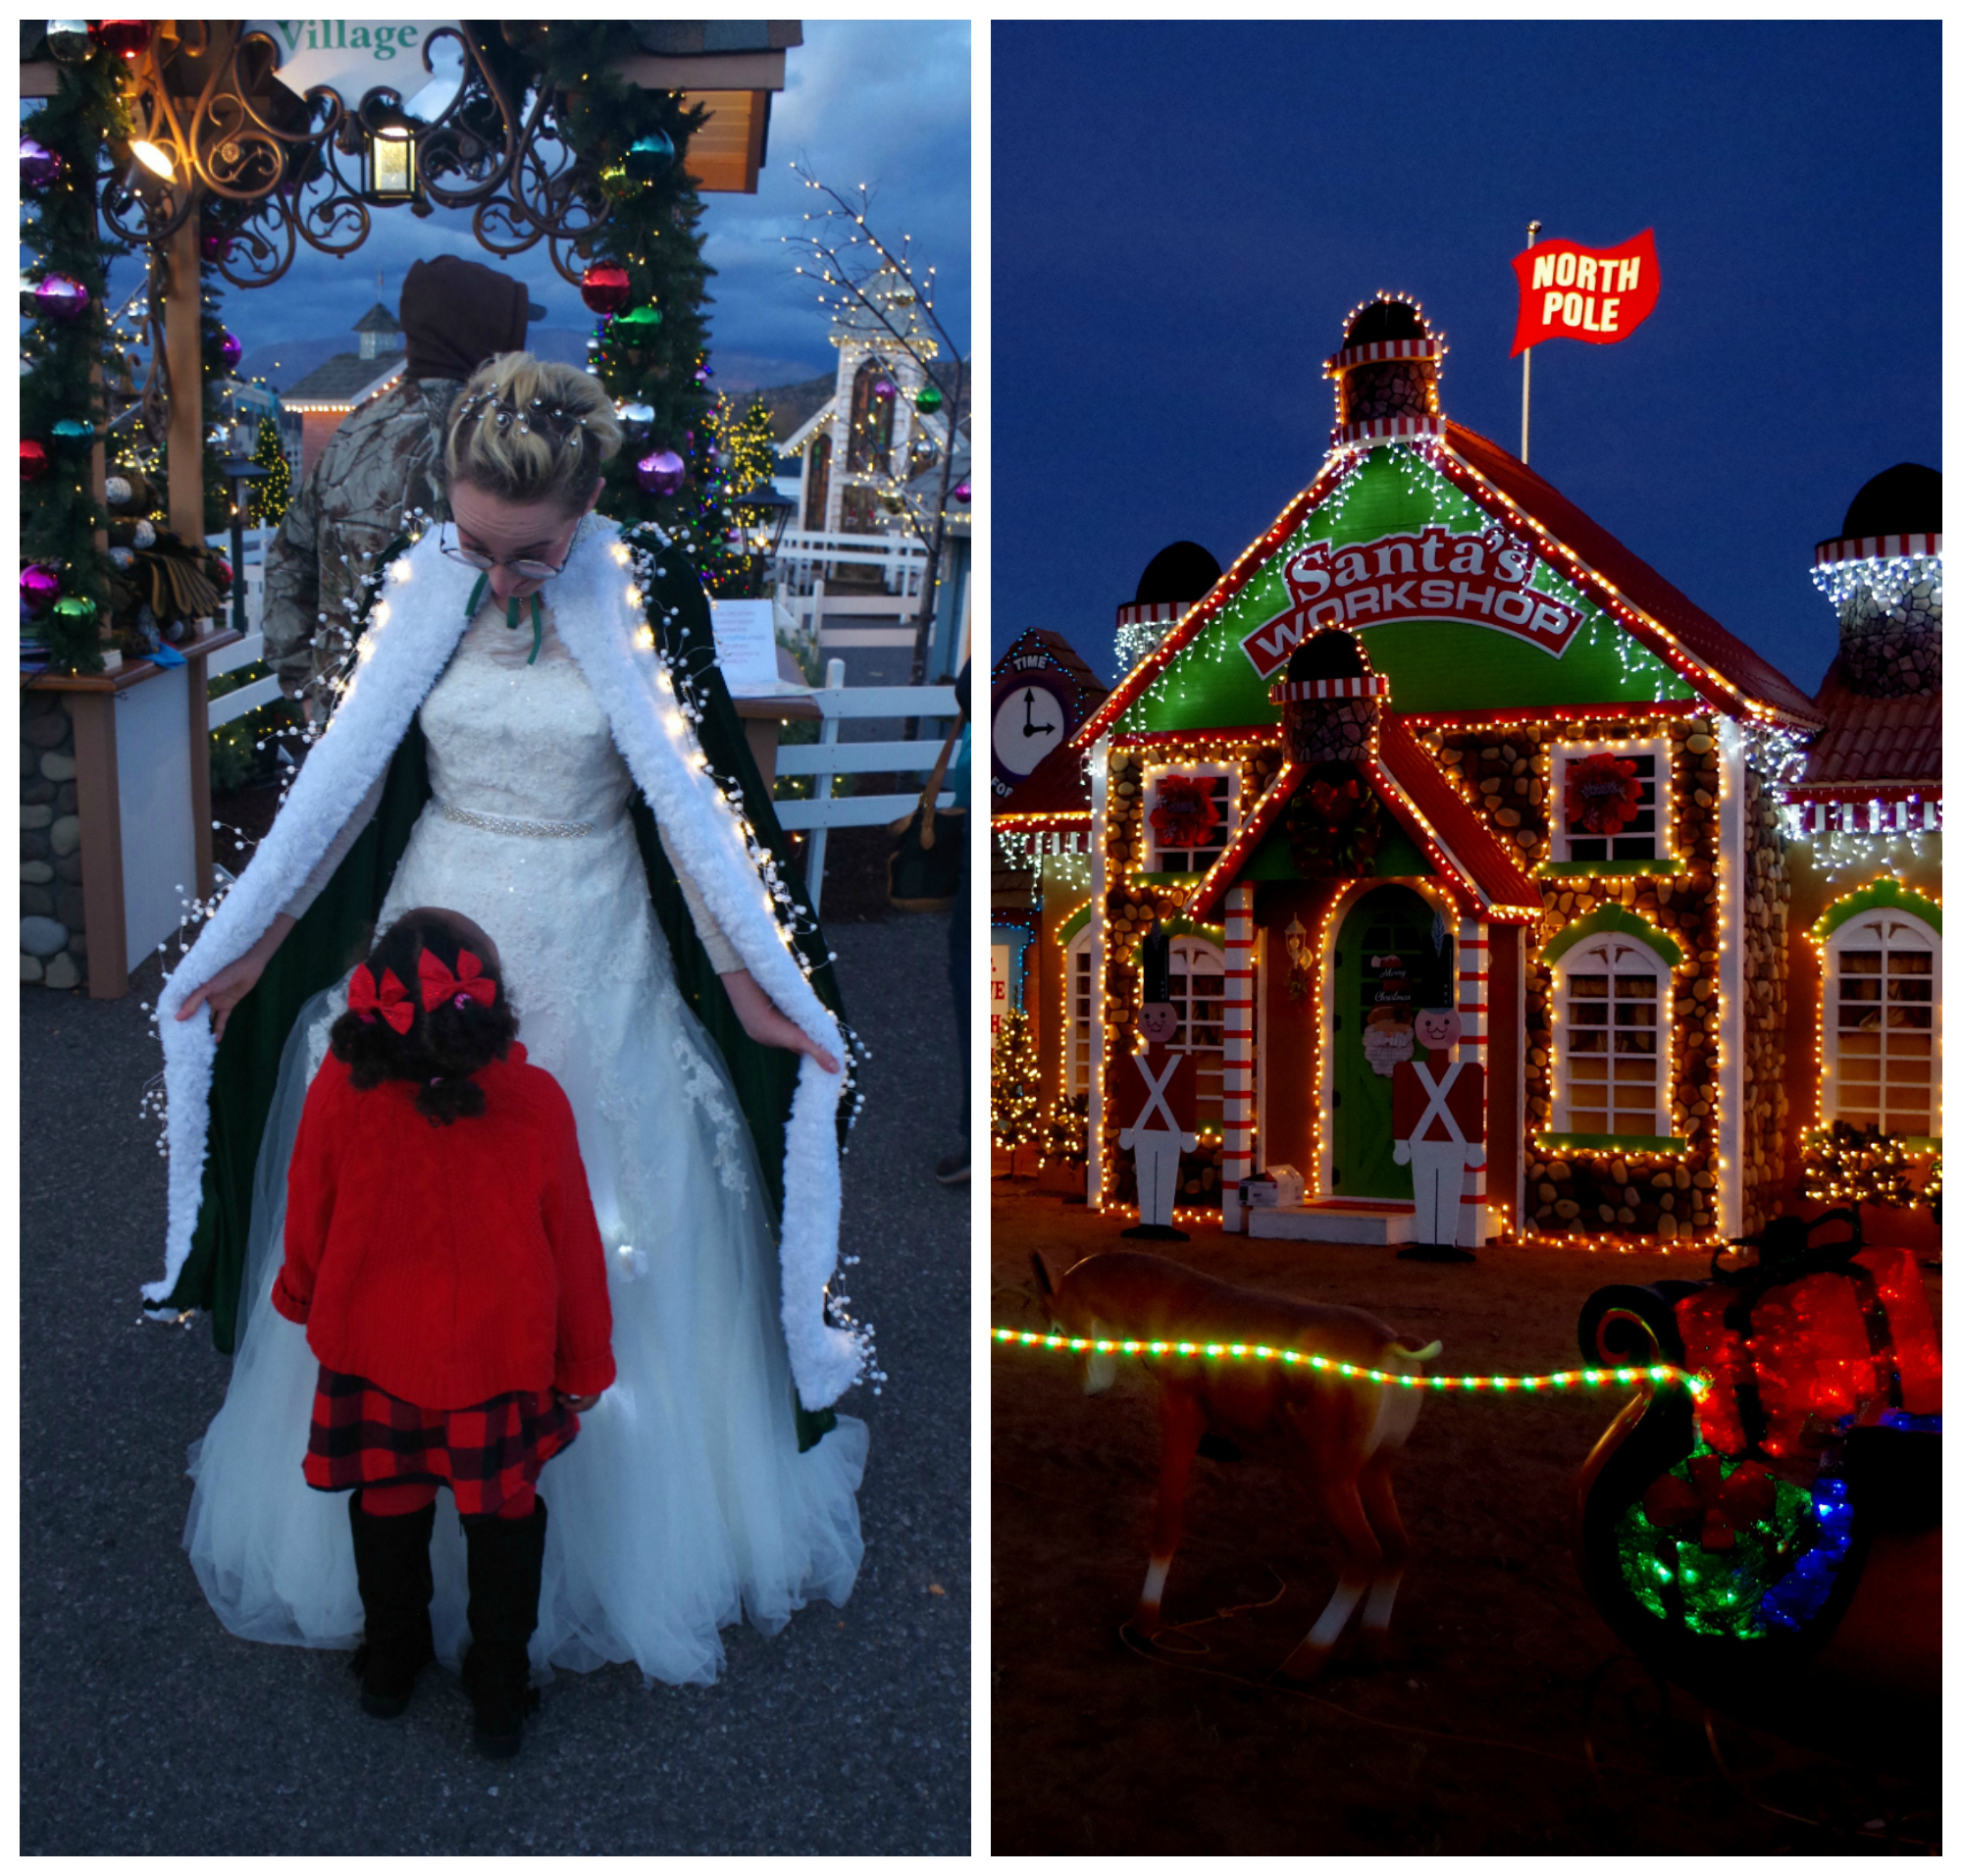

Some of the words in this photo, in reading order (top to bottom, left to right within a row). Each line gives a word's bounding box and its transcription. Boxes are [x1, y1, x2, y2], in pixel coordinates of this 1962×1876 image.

[277, 20, 418, 60] Village
[1532, 252, 1640, 292] NORTH
[1542, 291, 1620, 332] POLE
[1292, 533, 1528, 602] Santa's
[1256, 580, 1570, 657] WORKSHOP
[1013, 654, 1048, 671] TIME
[1379, 968, 1406, 978] Merry
[1374, 990, 1411, 1002] Christmas
